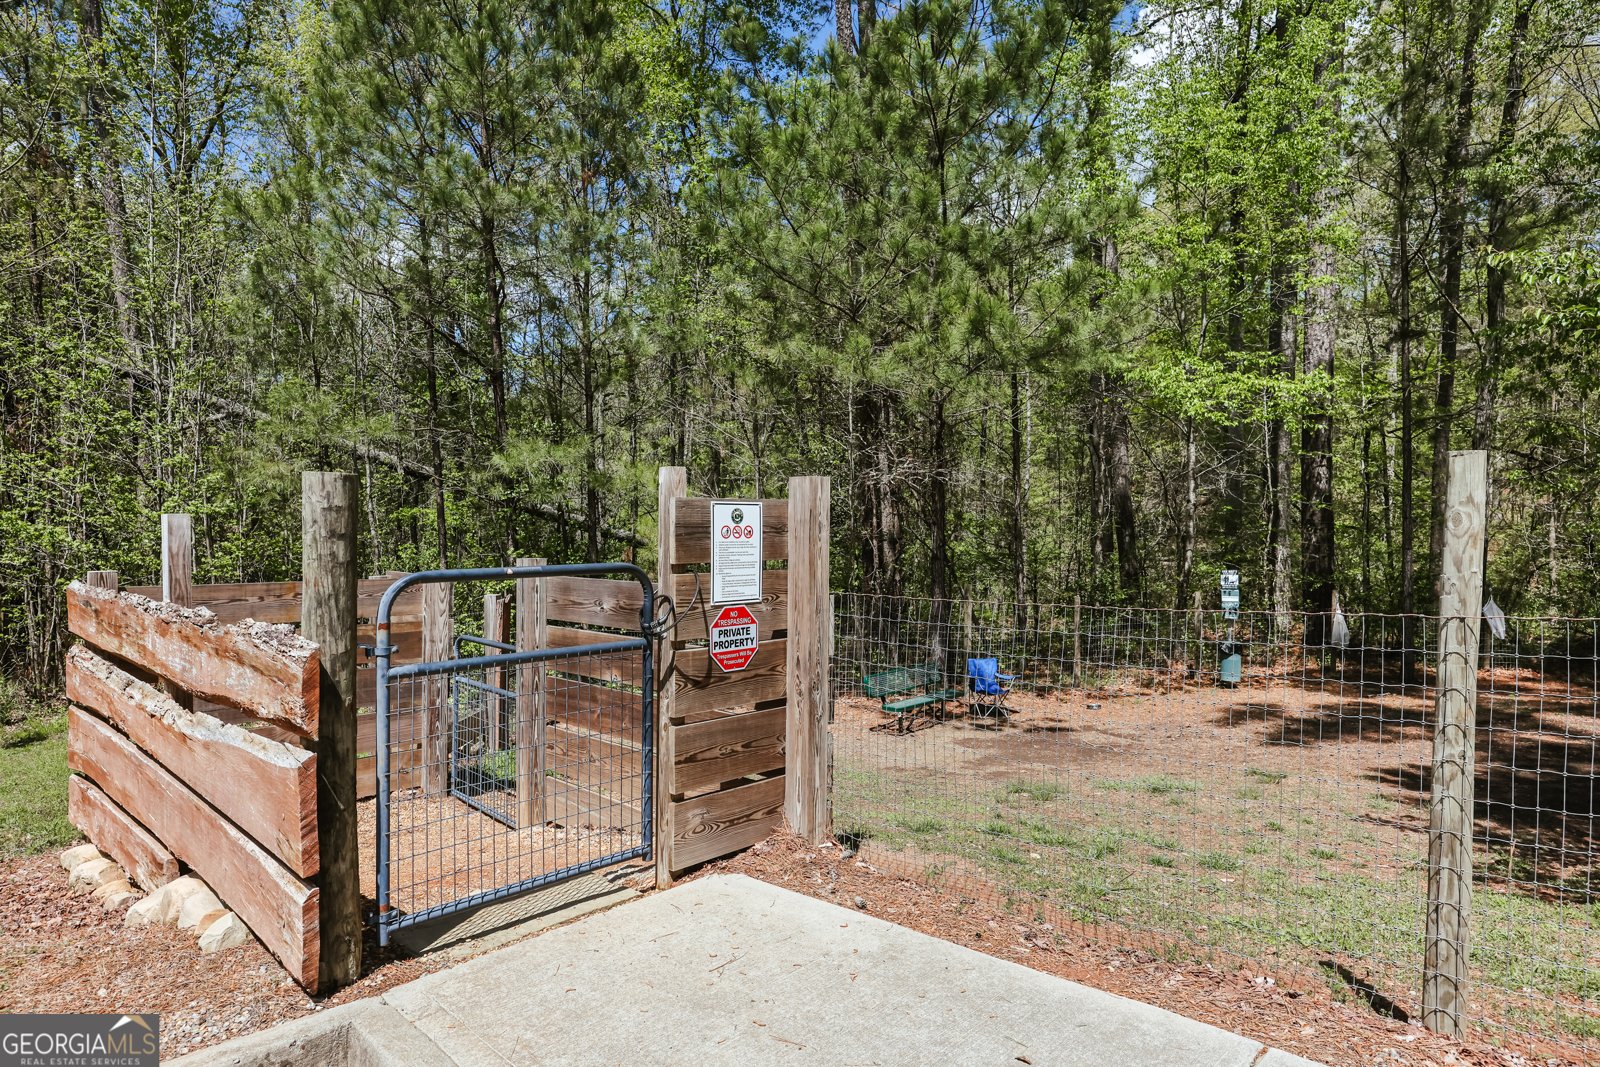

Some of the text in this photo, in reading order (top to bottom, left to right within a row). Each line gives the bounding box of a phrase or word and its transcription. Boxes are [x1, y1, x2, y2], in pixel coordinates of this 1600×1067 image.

[718, 617, 751, 626] TRESPASSING
[718, 627, 750, 638] PRIVATE
[713, 637, 755, 650] PROPERTY
